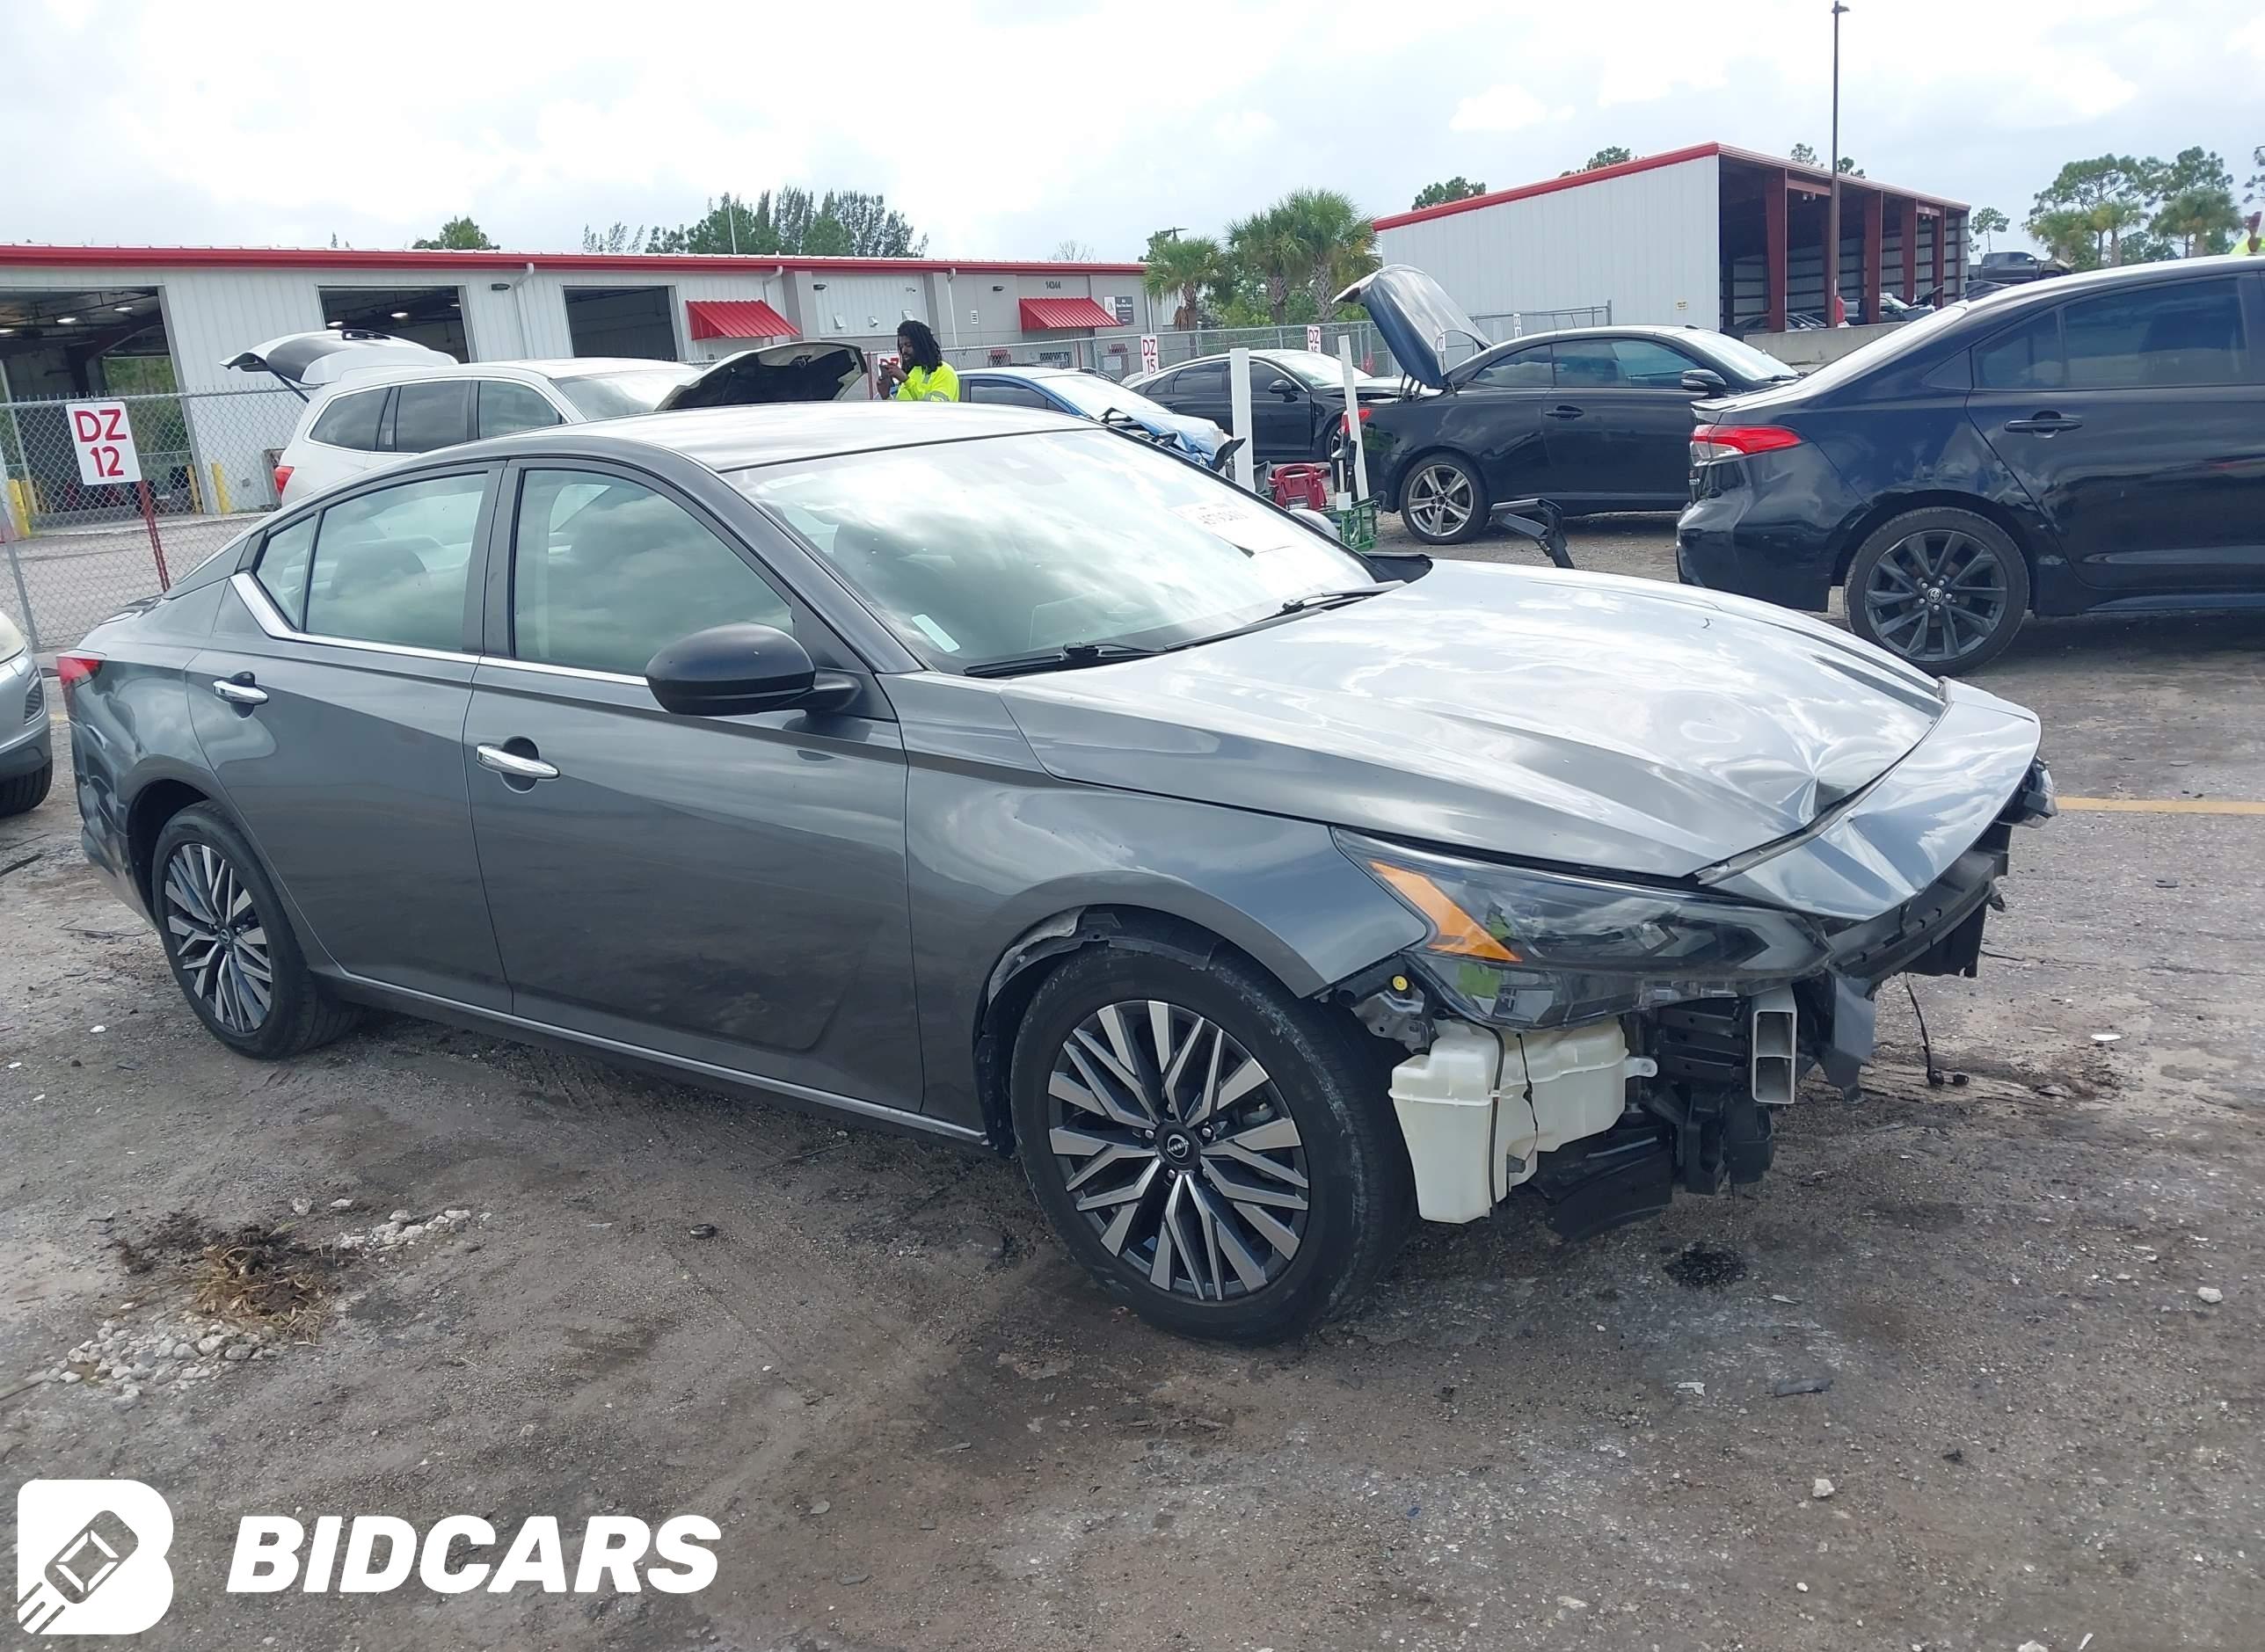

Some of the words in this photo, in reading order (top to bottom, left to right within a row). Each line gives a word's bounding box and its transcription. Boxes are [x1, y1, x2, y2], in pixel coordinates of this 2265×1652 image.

[1308, 329, 1320, 345] DZ
[1142, 338, 1157, 356] DZ
[1147, 358, 1156, 375] 15
[73, 409, 127, 442] DZ
[90, 446, 125, 477] 12
